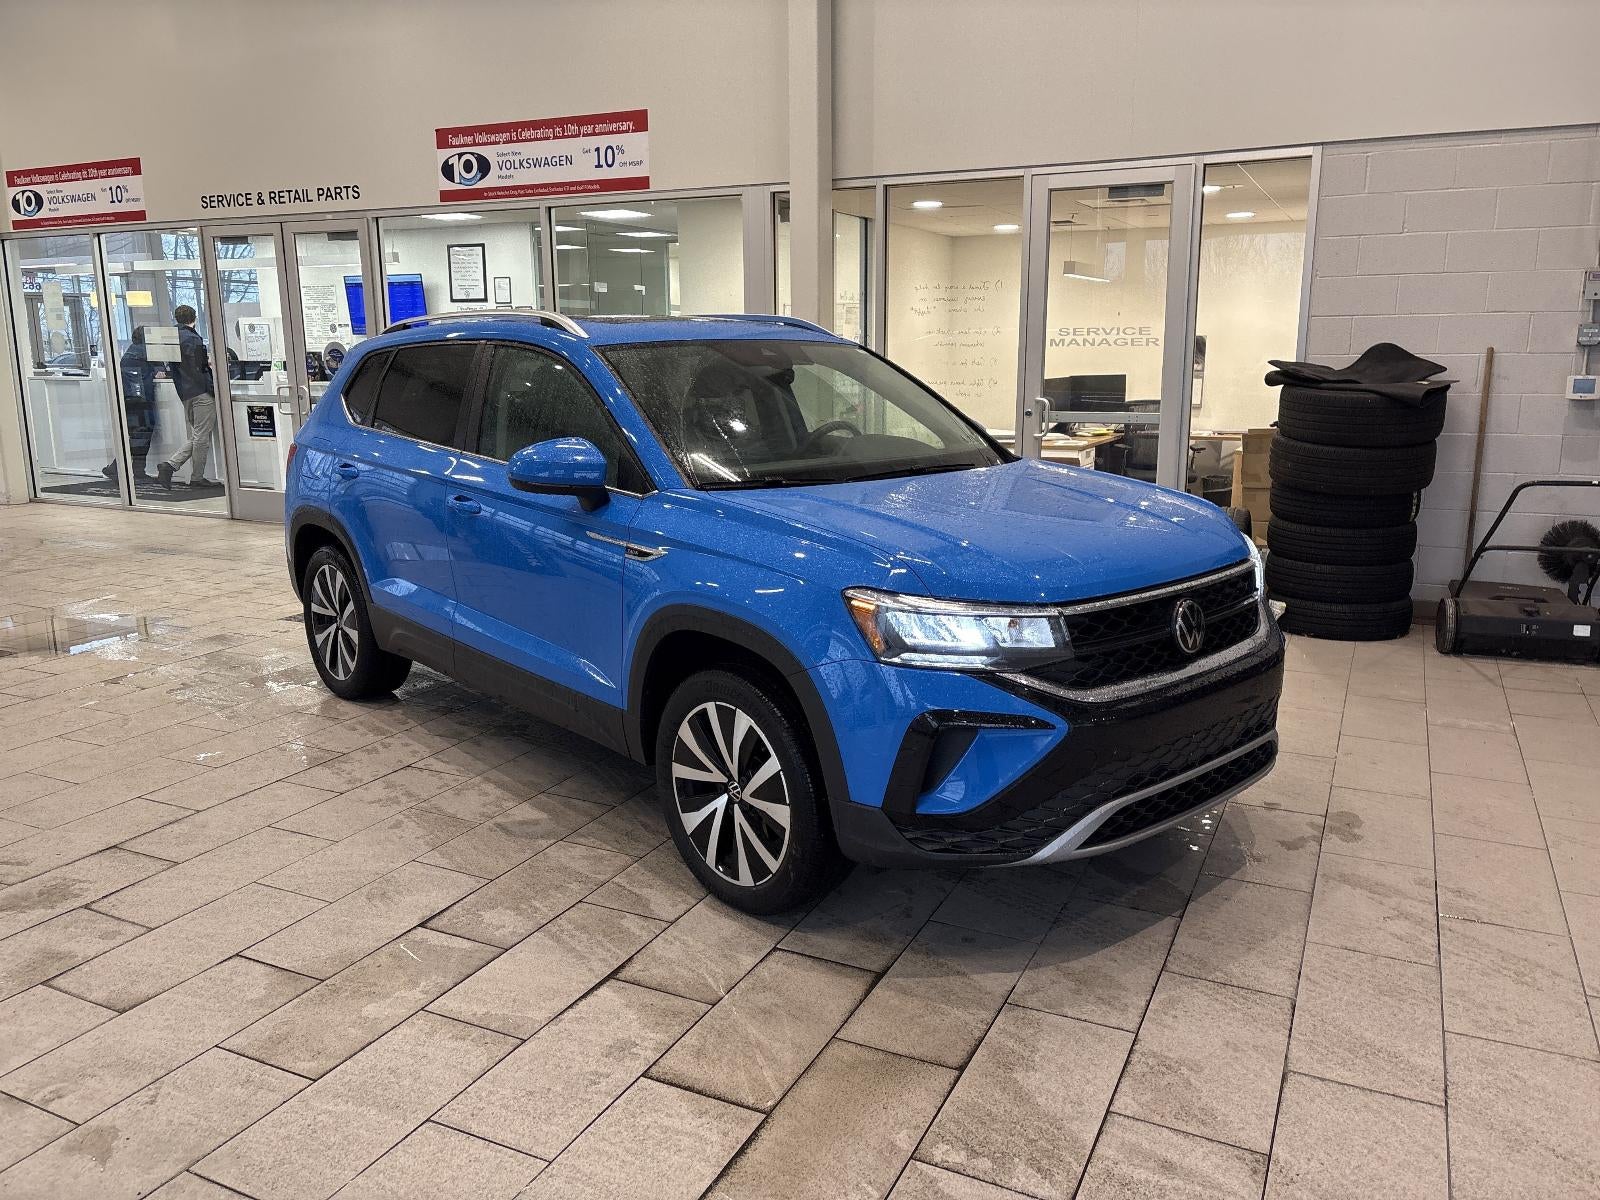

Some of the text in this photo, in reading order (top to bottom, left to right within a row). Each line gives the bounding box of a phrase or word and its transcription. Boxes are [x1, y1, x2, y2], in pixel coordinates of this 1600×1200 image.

[448, 134, 474, 146] Faulkner
[474, 130, 511, 145] Volkswagen
[511, 129, 517, 141] is
[517, 125, 554, 140] Celebrating
[563, 122, 579, 136] 10th
[579, 124, 595, 136] year
[448, 153, 478, 185] 10
[496, 154, 573, 171] VOLKSWAGEN
[15, 190, 36, 215] 10
[47, 192, 97, 205] VOLKSWAGEN
[201, 185, 361, 209] SERVICE & RETAIL PARTS
[1058, 326, 1151, 336] SERVICE
[1049, 338, 1160, 347] MANAGER
